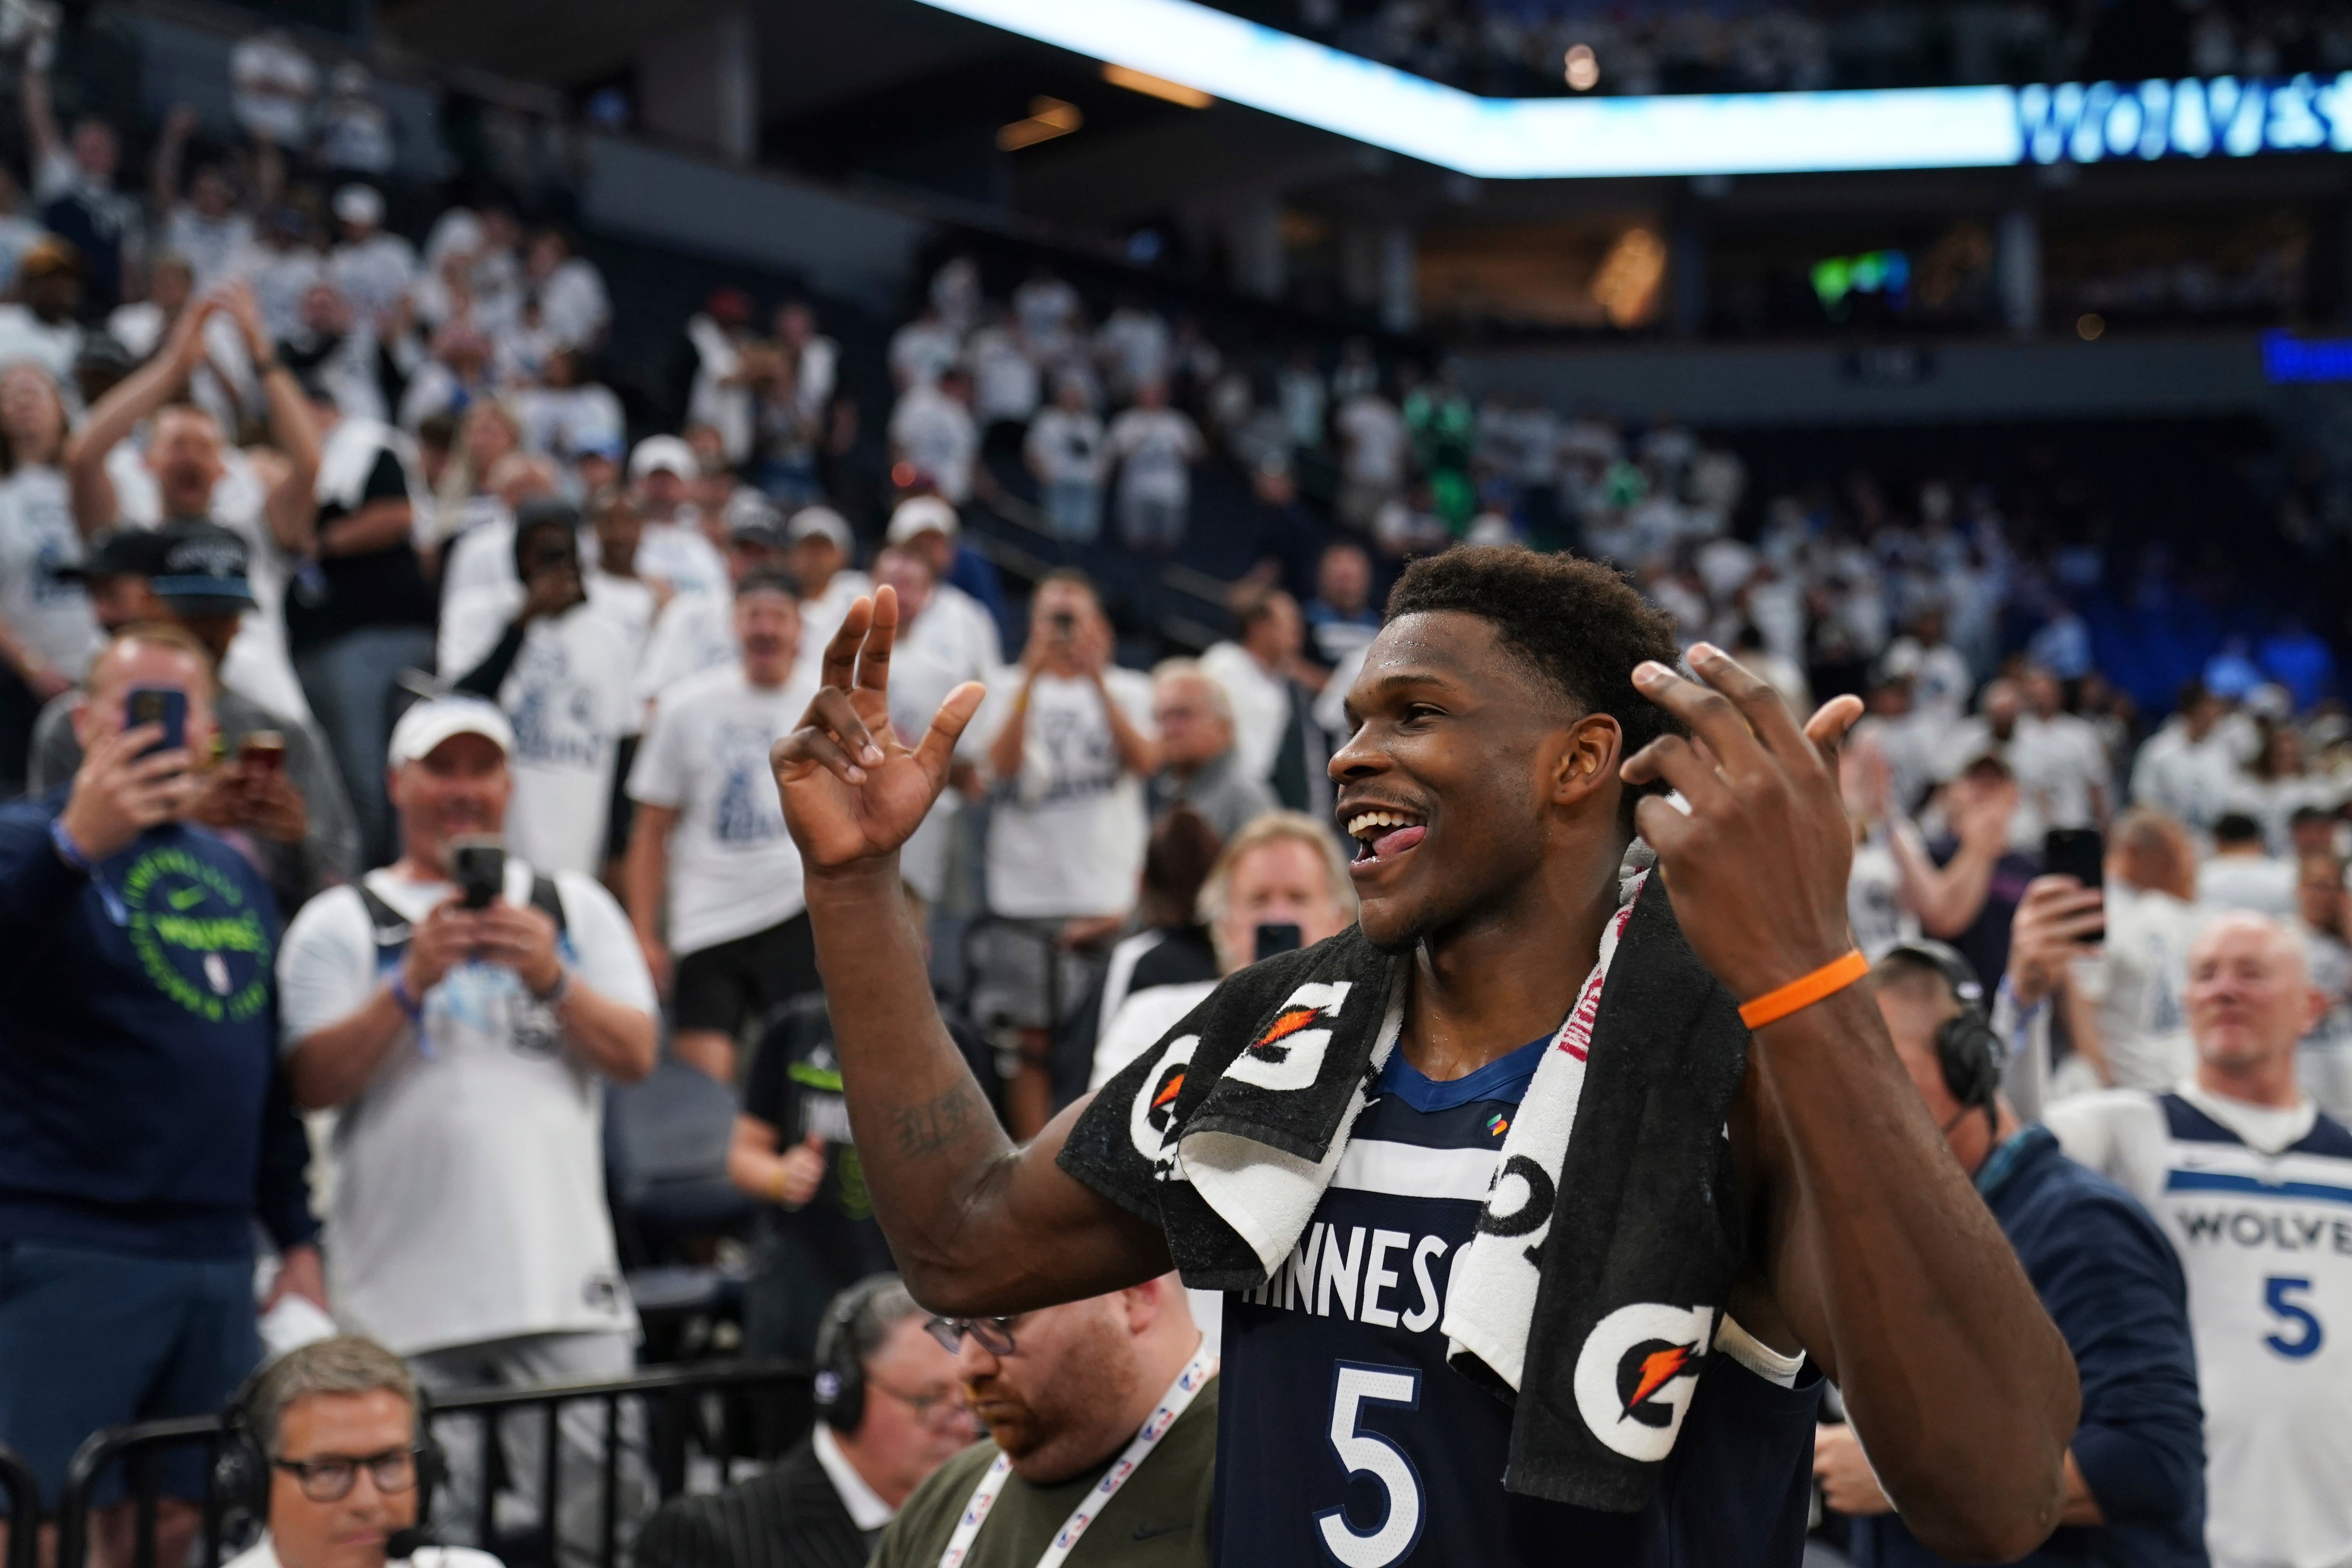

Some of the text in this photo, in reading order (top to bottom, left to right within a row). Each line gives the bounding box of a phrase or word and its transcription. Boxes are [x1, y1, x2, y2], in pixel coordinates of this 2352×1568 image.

[1242, 1221, 1473, 1333] NNES
[2267, 1277, 2321, 1358] 5
[1574, 1302, 1715, 1463] G
[1315, 1363, 1424, 1568] 5
